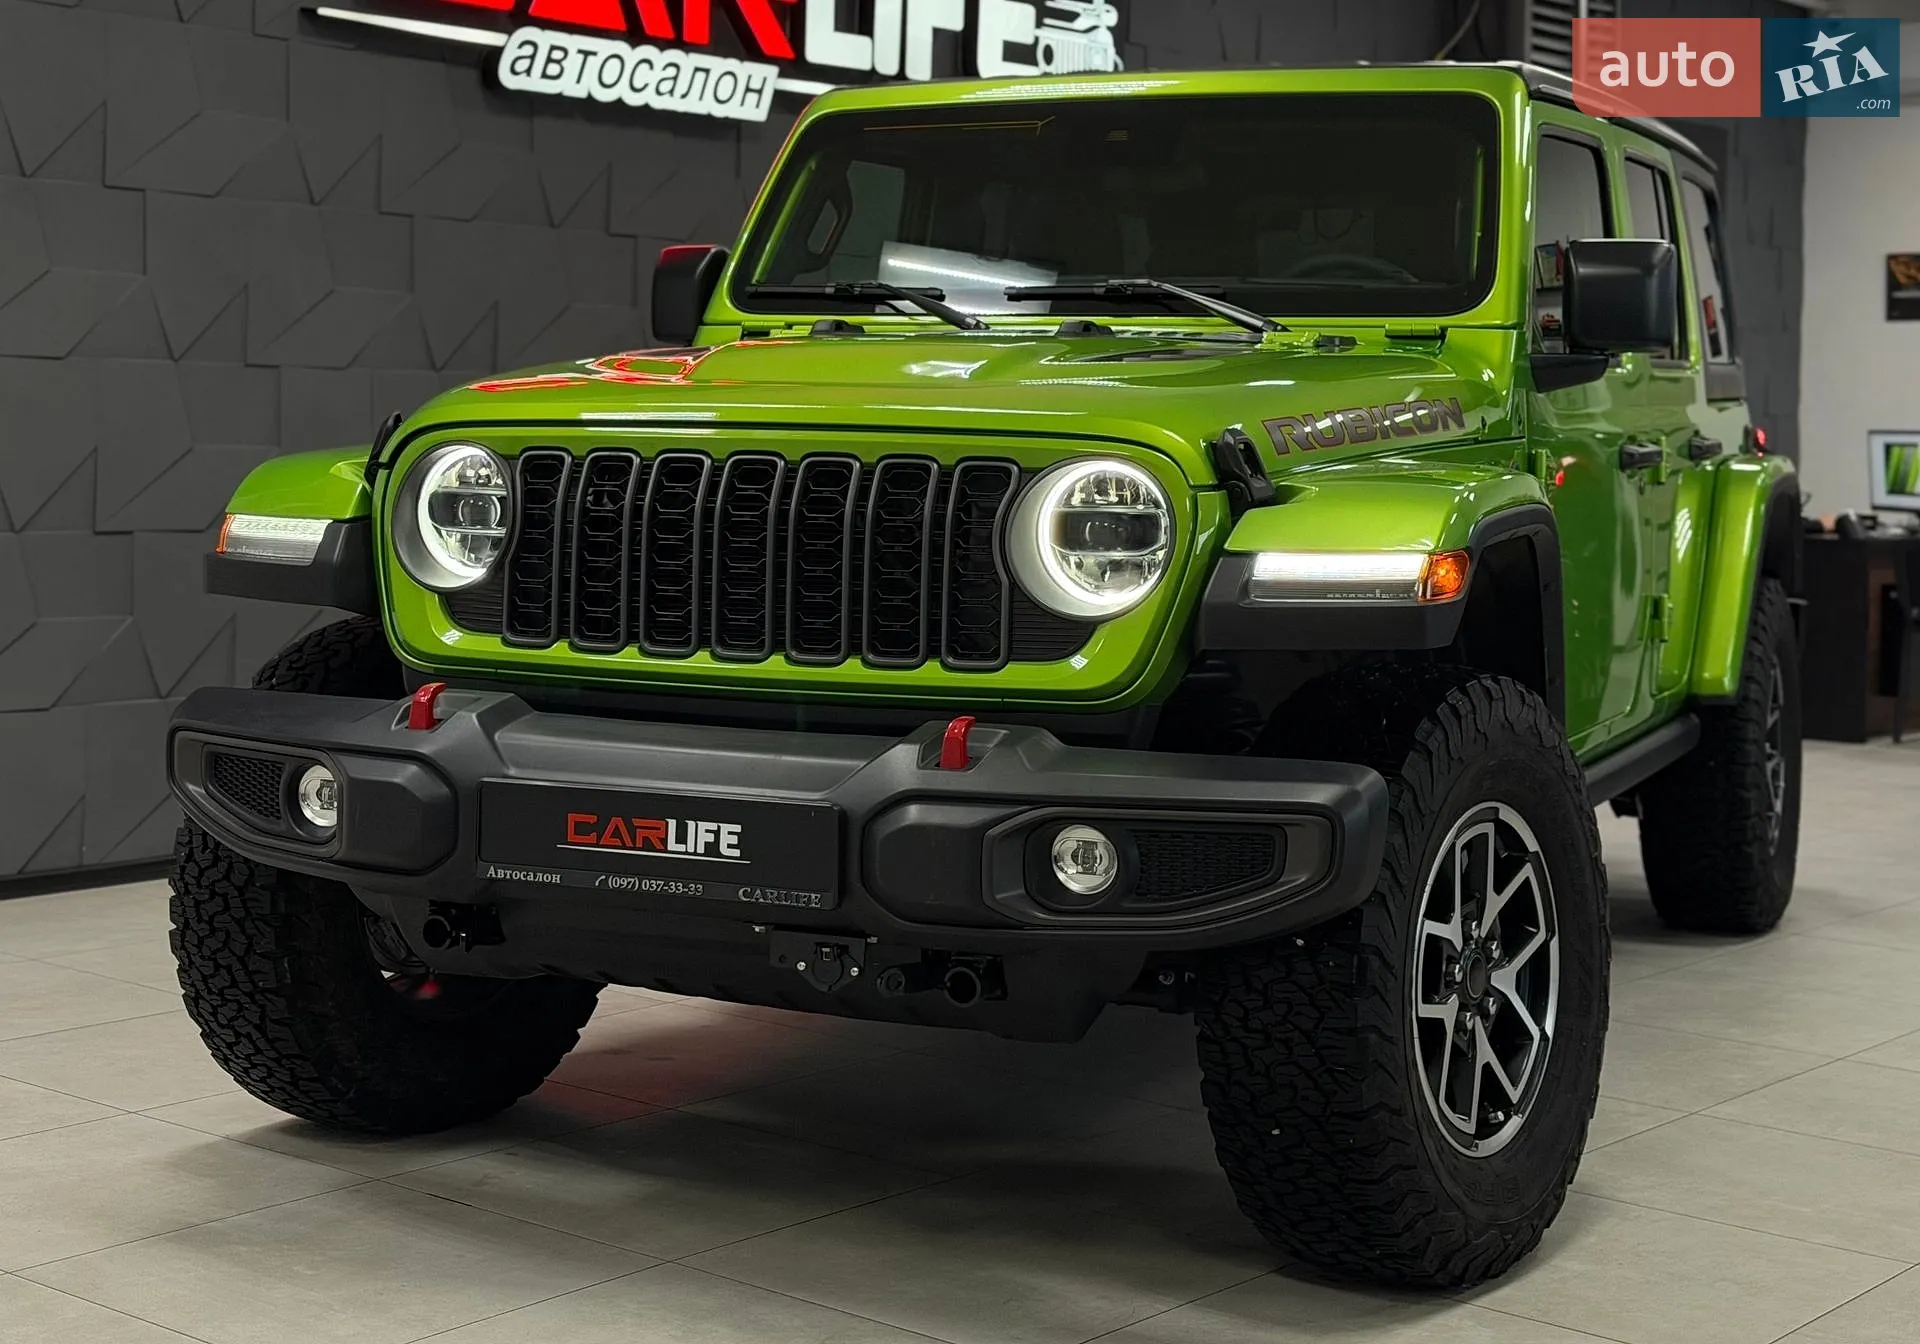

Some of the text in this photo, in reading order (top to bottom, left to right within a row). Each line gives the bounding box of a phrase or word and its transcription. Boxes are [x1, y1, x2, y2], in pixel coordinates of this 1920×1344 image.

[508, 39, 768, 109] автосалон
[1261, 397, 1467, 457] RUBICON
[567, 813, 742, 857] CARLIFE
[486, 865, 561, 884] Автосалон
[608, 875, 703, 897] (097) 037-33-33
[738, 887, 822, 908] CARLIFE
